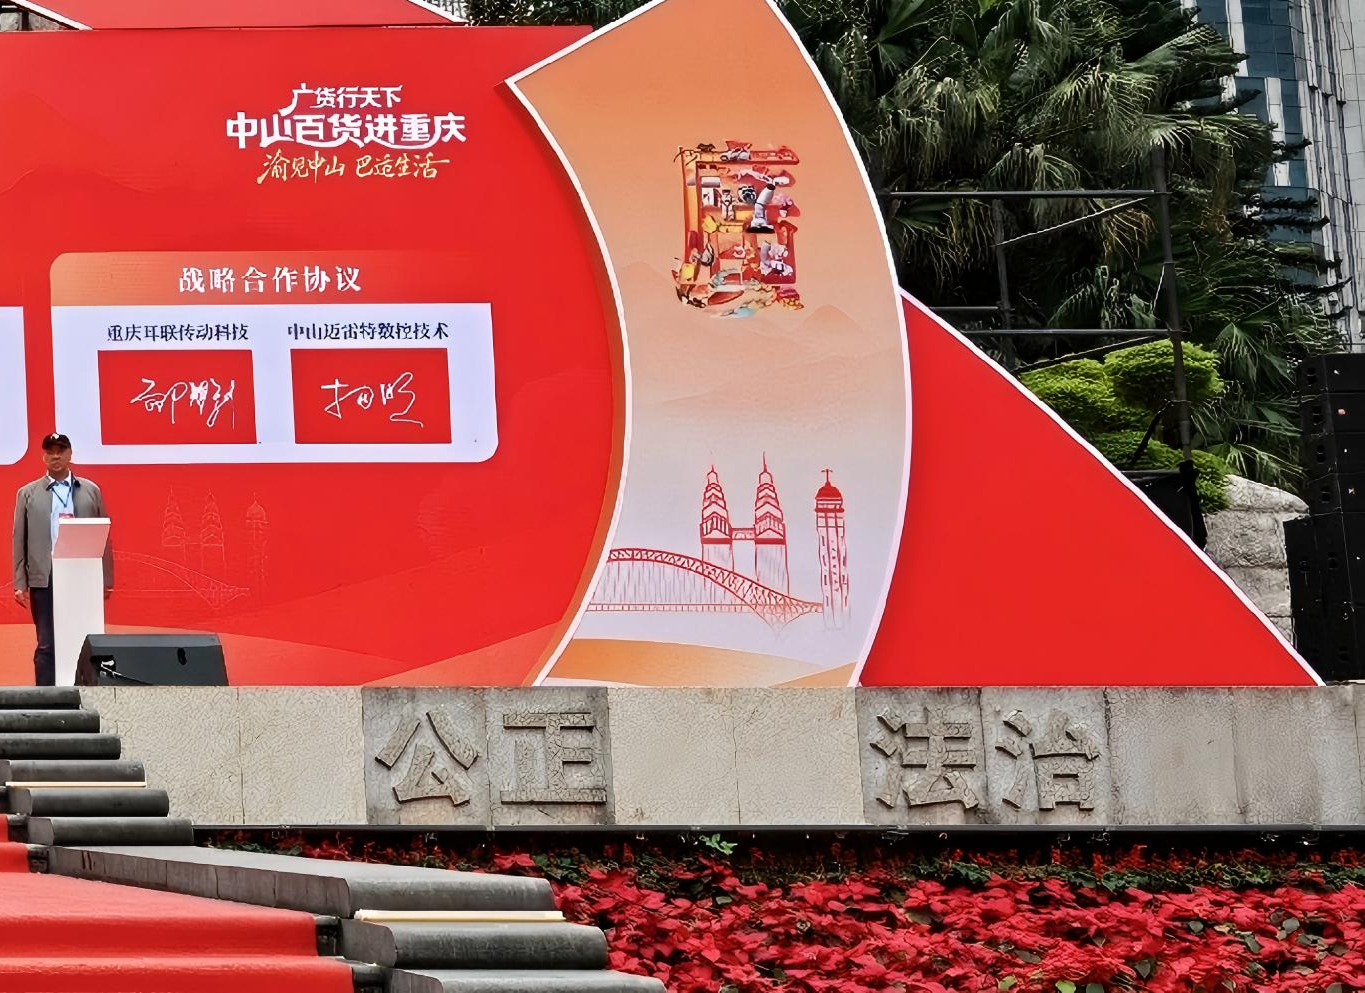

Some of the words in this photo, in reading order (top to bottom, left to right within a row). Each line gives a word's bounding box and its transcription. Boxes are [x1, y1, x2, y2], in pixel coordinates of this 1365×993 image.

[279, 83, 403, 117] 广货行天下
[226, 111, 467, 149] 中山百货进重庆
[256, 149, 345, 185] 渝见中山
[355, 152, 450, 179] 巴适生活
[179, 266, 361, 293] 战略合作协议
[375, 710, 608, 808] 公正
[870, 707, 1102, 813] 法治
